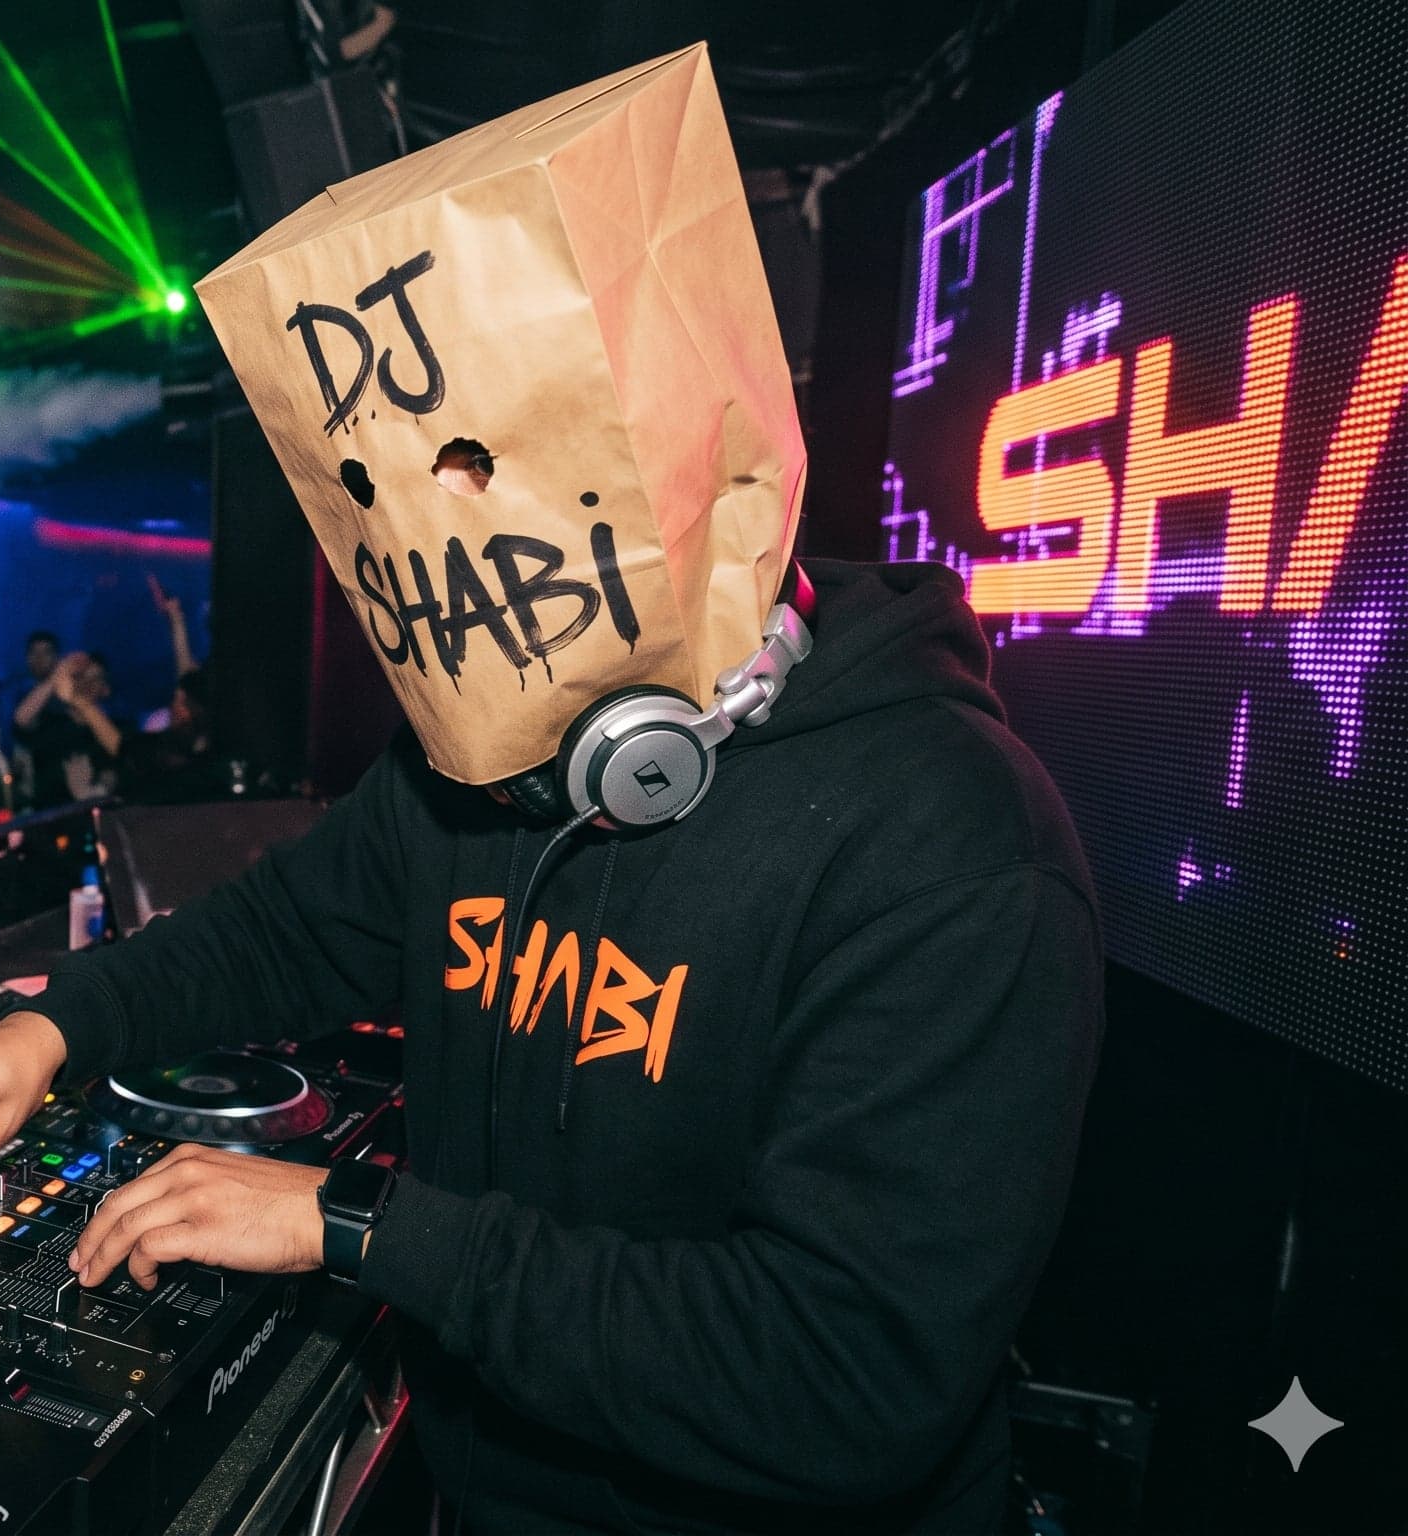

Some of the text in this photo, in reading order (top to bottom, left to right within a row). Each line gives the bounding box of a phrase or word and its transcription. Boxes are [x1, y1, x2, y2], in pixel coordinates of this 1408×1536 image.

[286, 250, 445, 437] DJ
[444, 896, 689, 1083] SHABI
[207, 1309, 279, 1415] Pioneer
